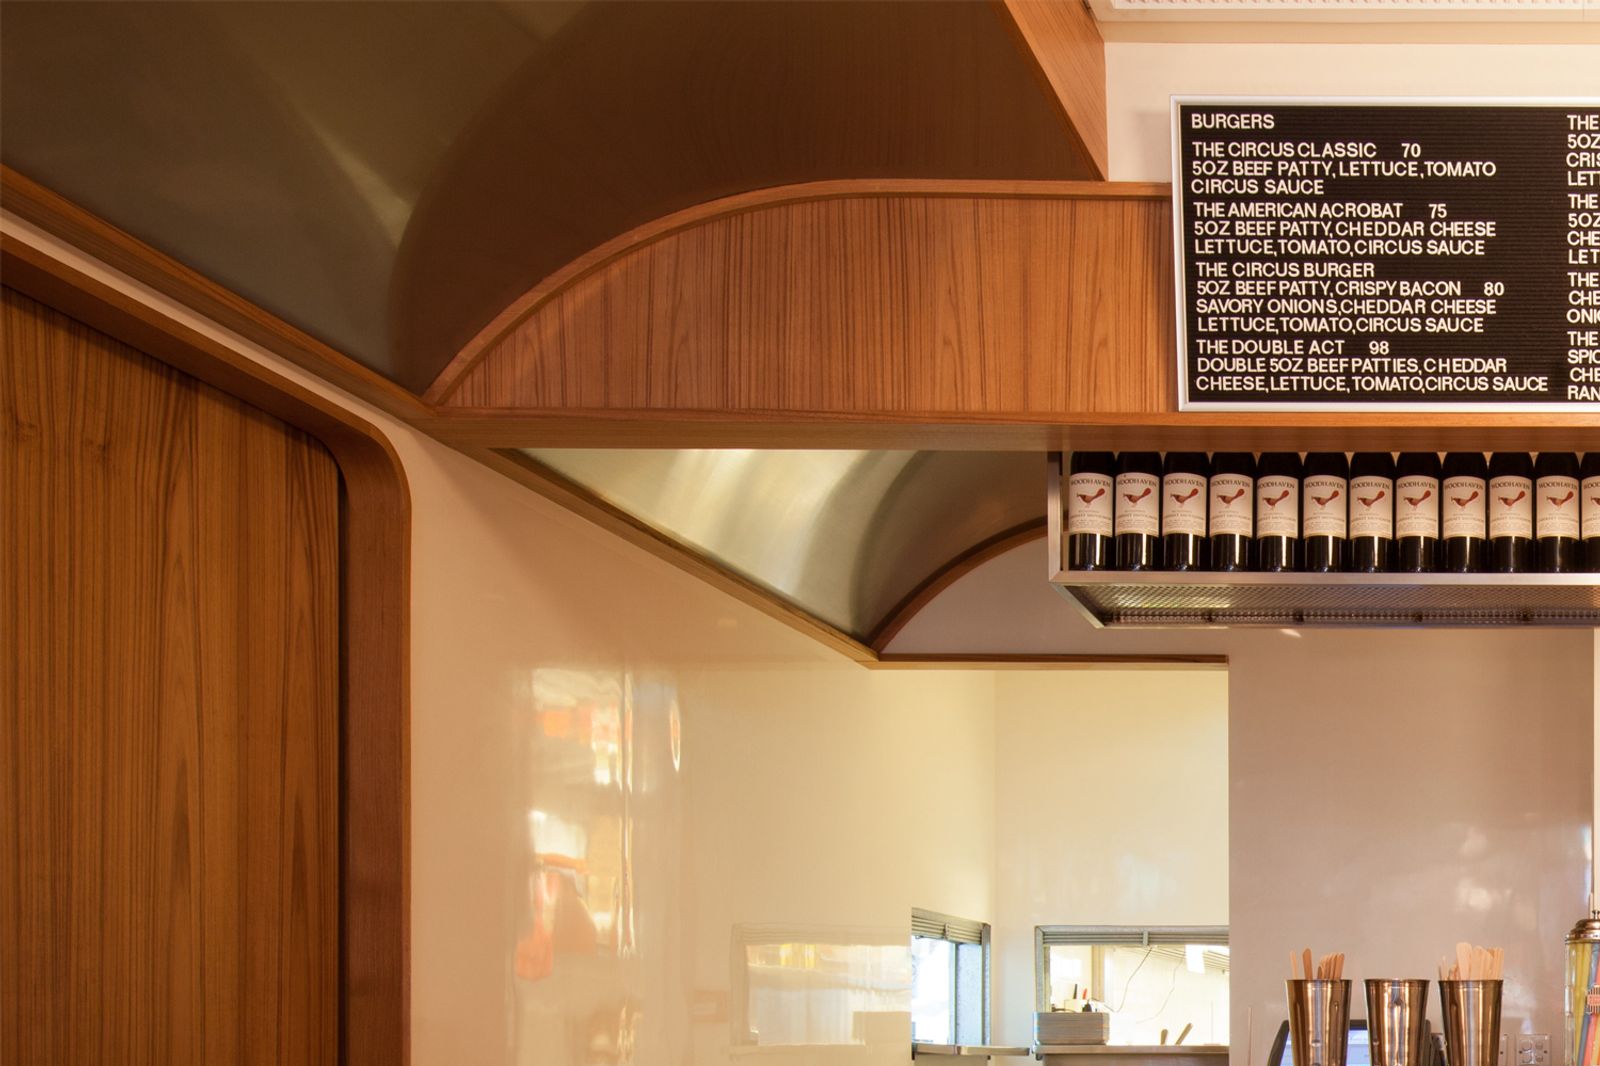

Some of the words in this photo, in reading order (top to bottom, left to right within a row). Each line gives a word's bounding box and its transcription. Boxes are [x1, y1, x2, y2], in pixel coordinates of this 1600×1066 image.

[1192, 114, 1274, 129] BURGERS
[1567, 115, 1599, 130] THE
[1192, 142, 1224, 157] THE
[1228, 142, 1294, 157] CIRCUS
[1298, 142, 1376, 158] CLASSIC
[1402, 143, 1421, 158] 70
[1233, 161, 1272, 175] BEEF
[1191, 179, 1258, 194] CIRCUS
[1265, 179, 1324, 194] SAUCE
[1568, 194, 1598, 209] THE
[1193, 202, 1225, 217] THE
[1228, 202, 1316, 218] AMERICAN
[1320, 203, 1403, 218] ACROBAT
[1429, 204, 1447, 219] 75
[1196, 262, 1227, 276] THE
[1233, 262, 1299, 277] CIRCUS
[1304, 263, 1374, 277] BURGER
[1567, 272, 1599, 287] THE
[1236, 281, 1276, 295] BEEF
[1336, 281, 1397, 295] CRISPY
[1400, 281, 1461, 296] BACON
[1484, 282, 1504, 296] 80
[1567, 331, 1598, 346] THE
[1196, 340, 1228, 354] THE
[1232, 340, 1304, 354] DOUBLE
[1309, 340, 1344, 354] ACT
[1369, 341, 1389, 355] 98
[1198, 358, 1266, 372] DOUBLE
[1308, 358, 1349, 372] BEEF
[1424, 358, 1506, 373] CHEDDAR
